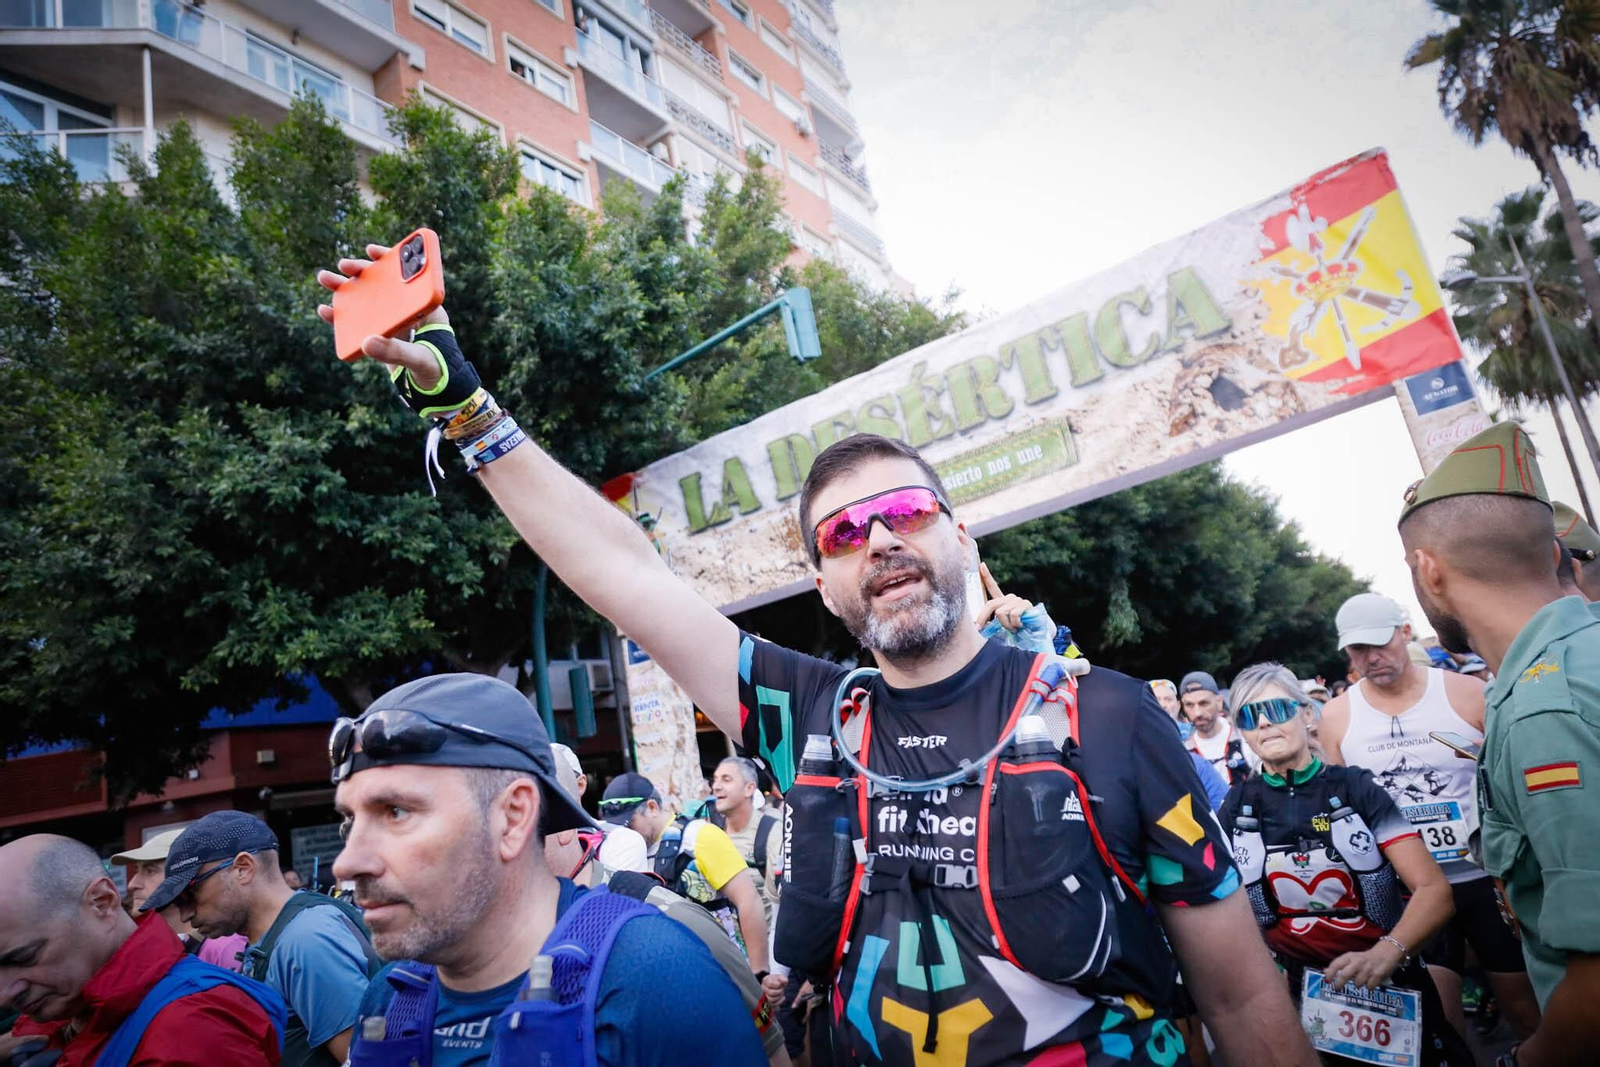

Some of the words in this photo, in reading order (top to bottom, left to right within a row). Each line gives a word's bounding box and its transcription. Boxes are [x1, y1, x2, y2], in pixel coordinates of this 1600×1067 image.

[941, 465, 983, 490] sierto
[987, 454, 1012, 476] nos
[1016, 444, 1043, 464] une
[679, 456, 762, 535] LA
[897, 735, 948, 748] FASTER
[1368, 744, 1385, 753] CLUB
[1386, 741, 1397, 749] DE
[784, 802, 794, 883] AONIJE
[878, 844, 954, 861] RUNNING
[1338, 1010, 1391, 1046] 366
[442, 1039, 483, 1049] EVENTS
